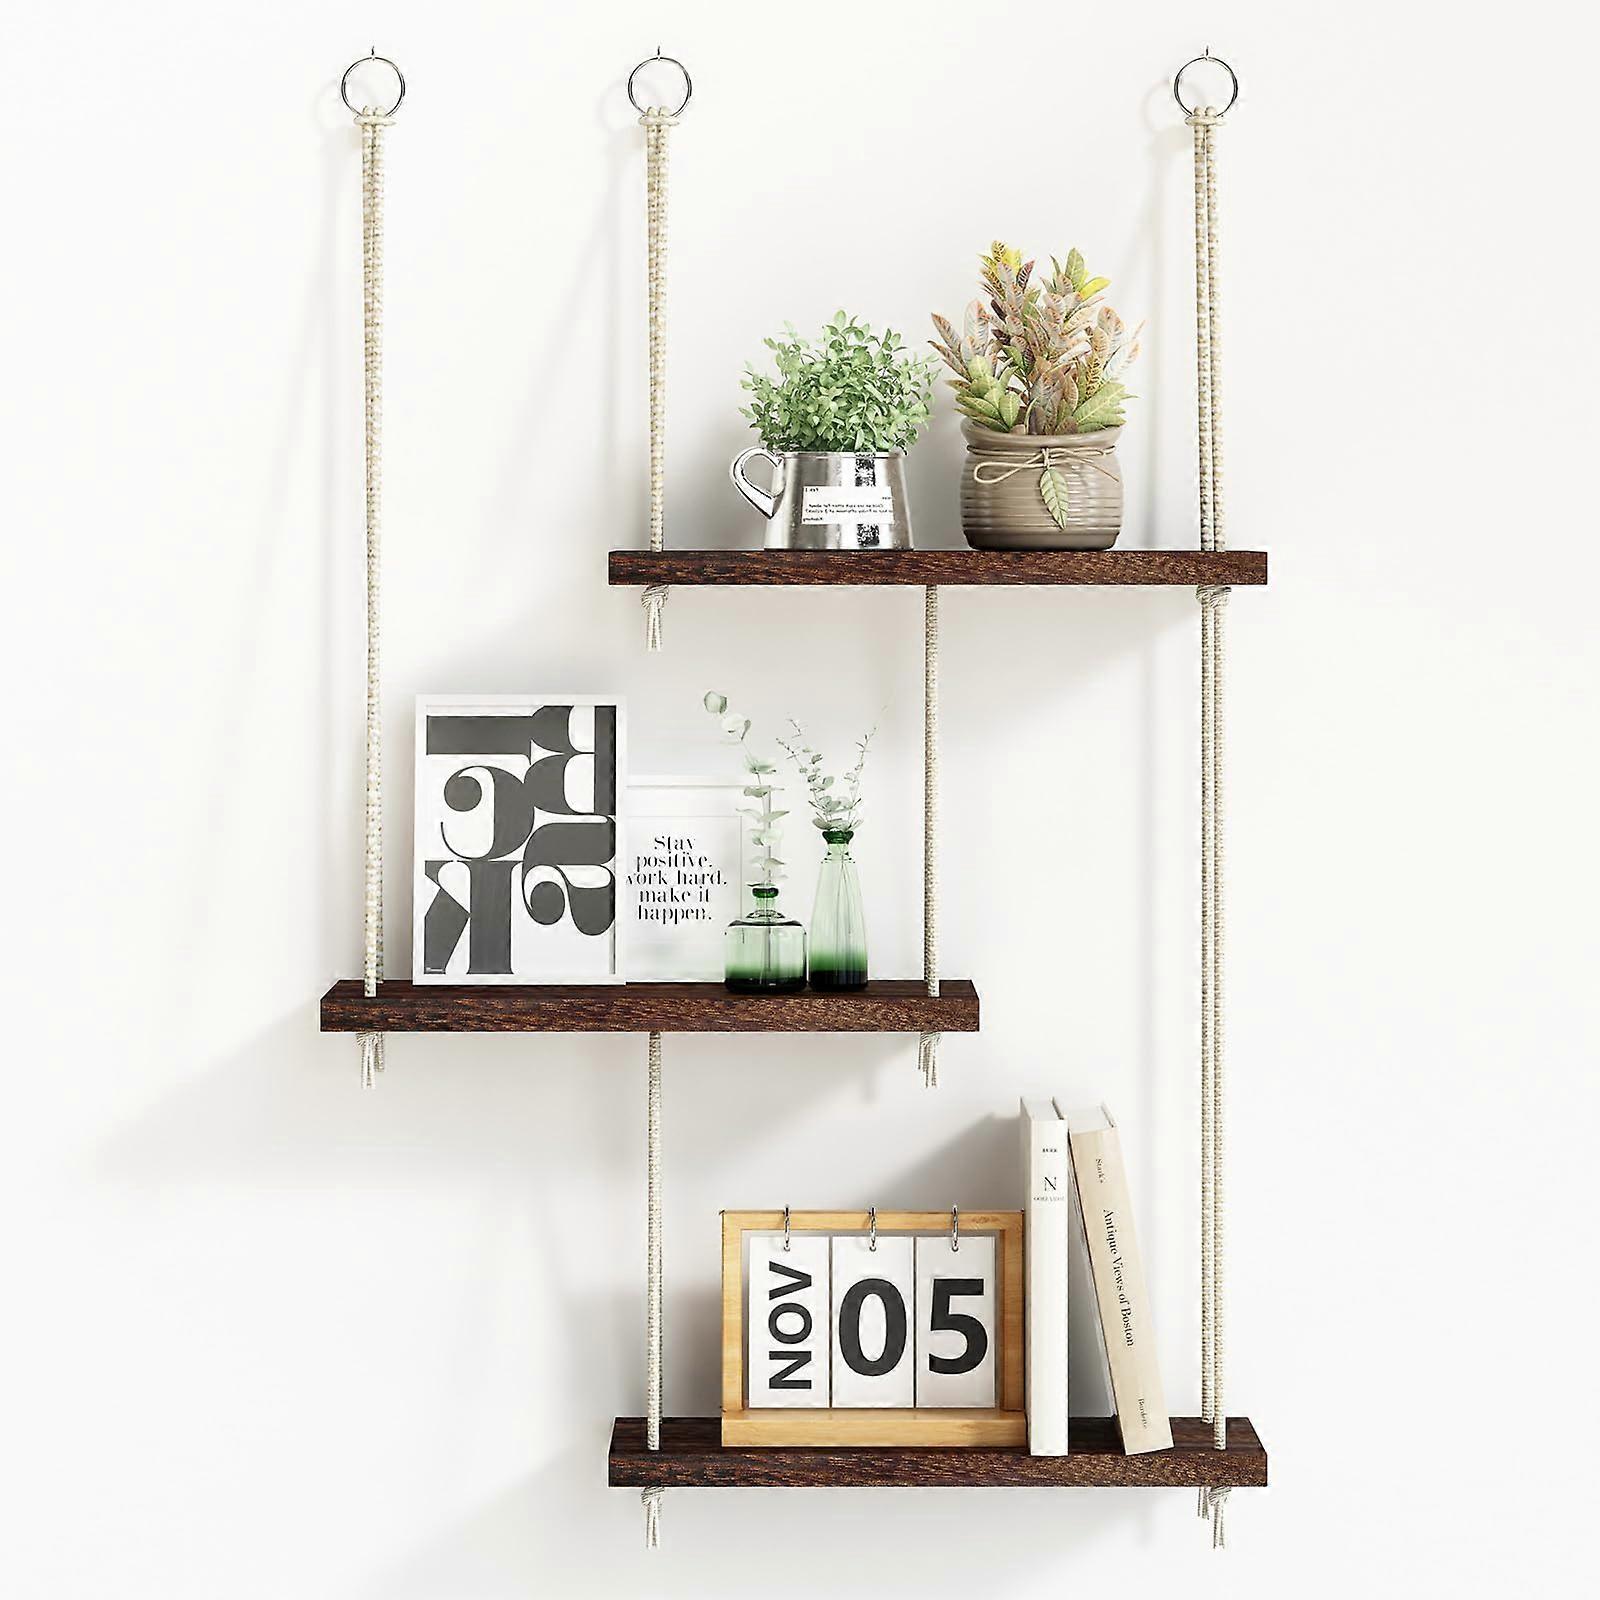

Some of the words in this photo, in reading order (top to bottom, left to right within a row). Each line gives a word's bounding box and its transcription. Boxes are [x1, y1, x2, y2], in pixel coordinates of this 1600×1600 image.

[654, 835, 696, 855] Stay
[636, 851, 713, 873] positive.
[677, 869, 727, 885] hard.
[640, 887, 691, 903] make
[699, 885, 709, 903] it
[638, 904, 712, 925] happen.
[1043, 1176, 1057, 1192] N
[1103, 1209, 1119, 1255] Antique
[1112, 1256, 1125, 1292] Views
[1118, 1293, 1130, 1304] of
[768, 1260, 813, 1390] NOV
[1120, 1307, 1135, 1347] Boston
